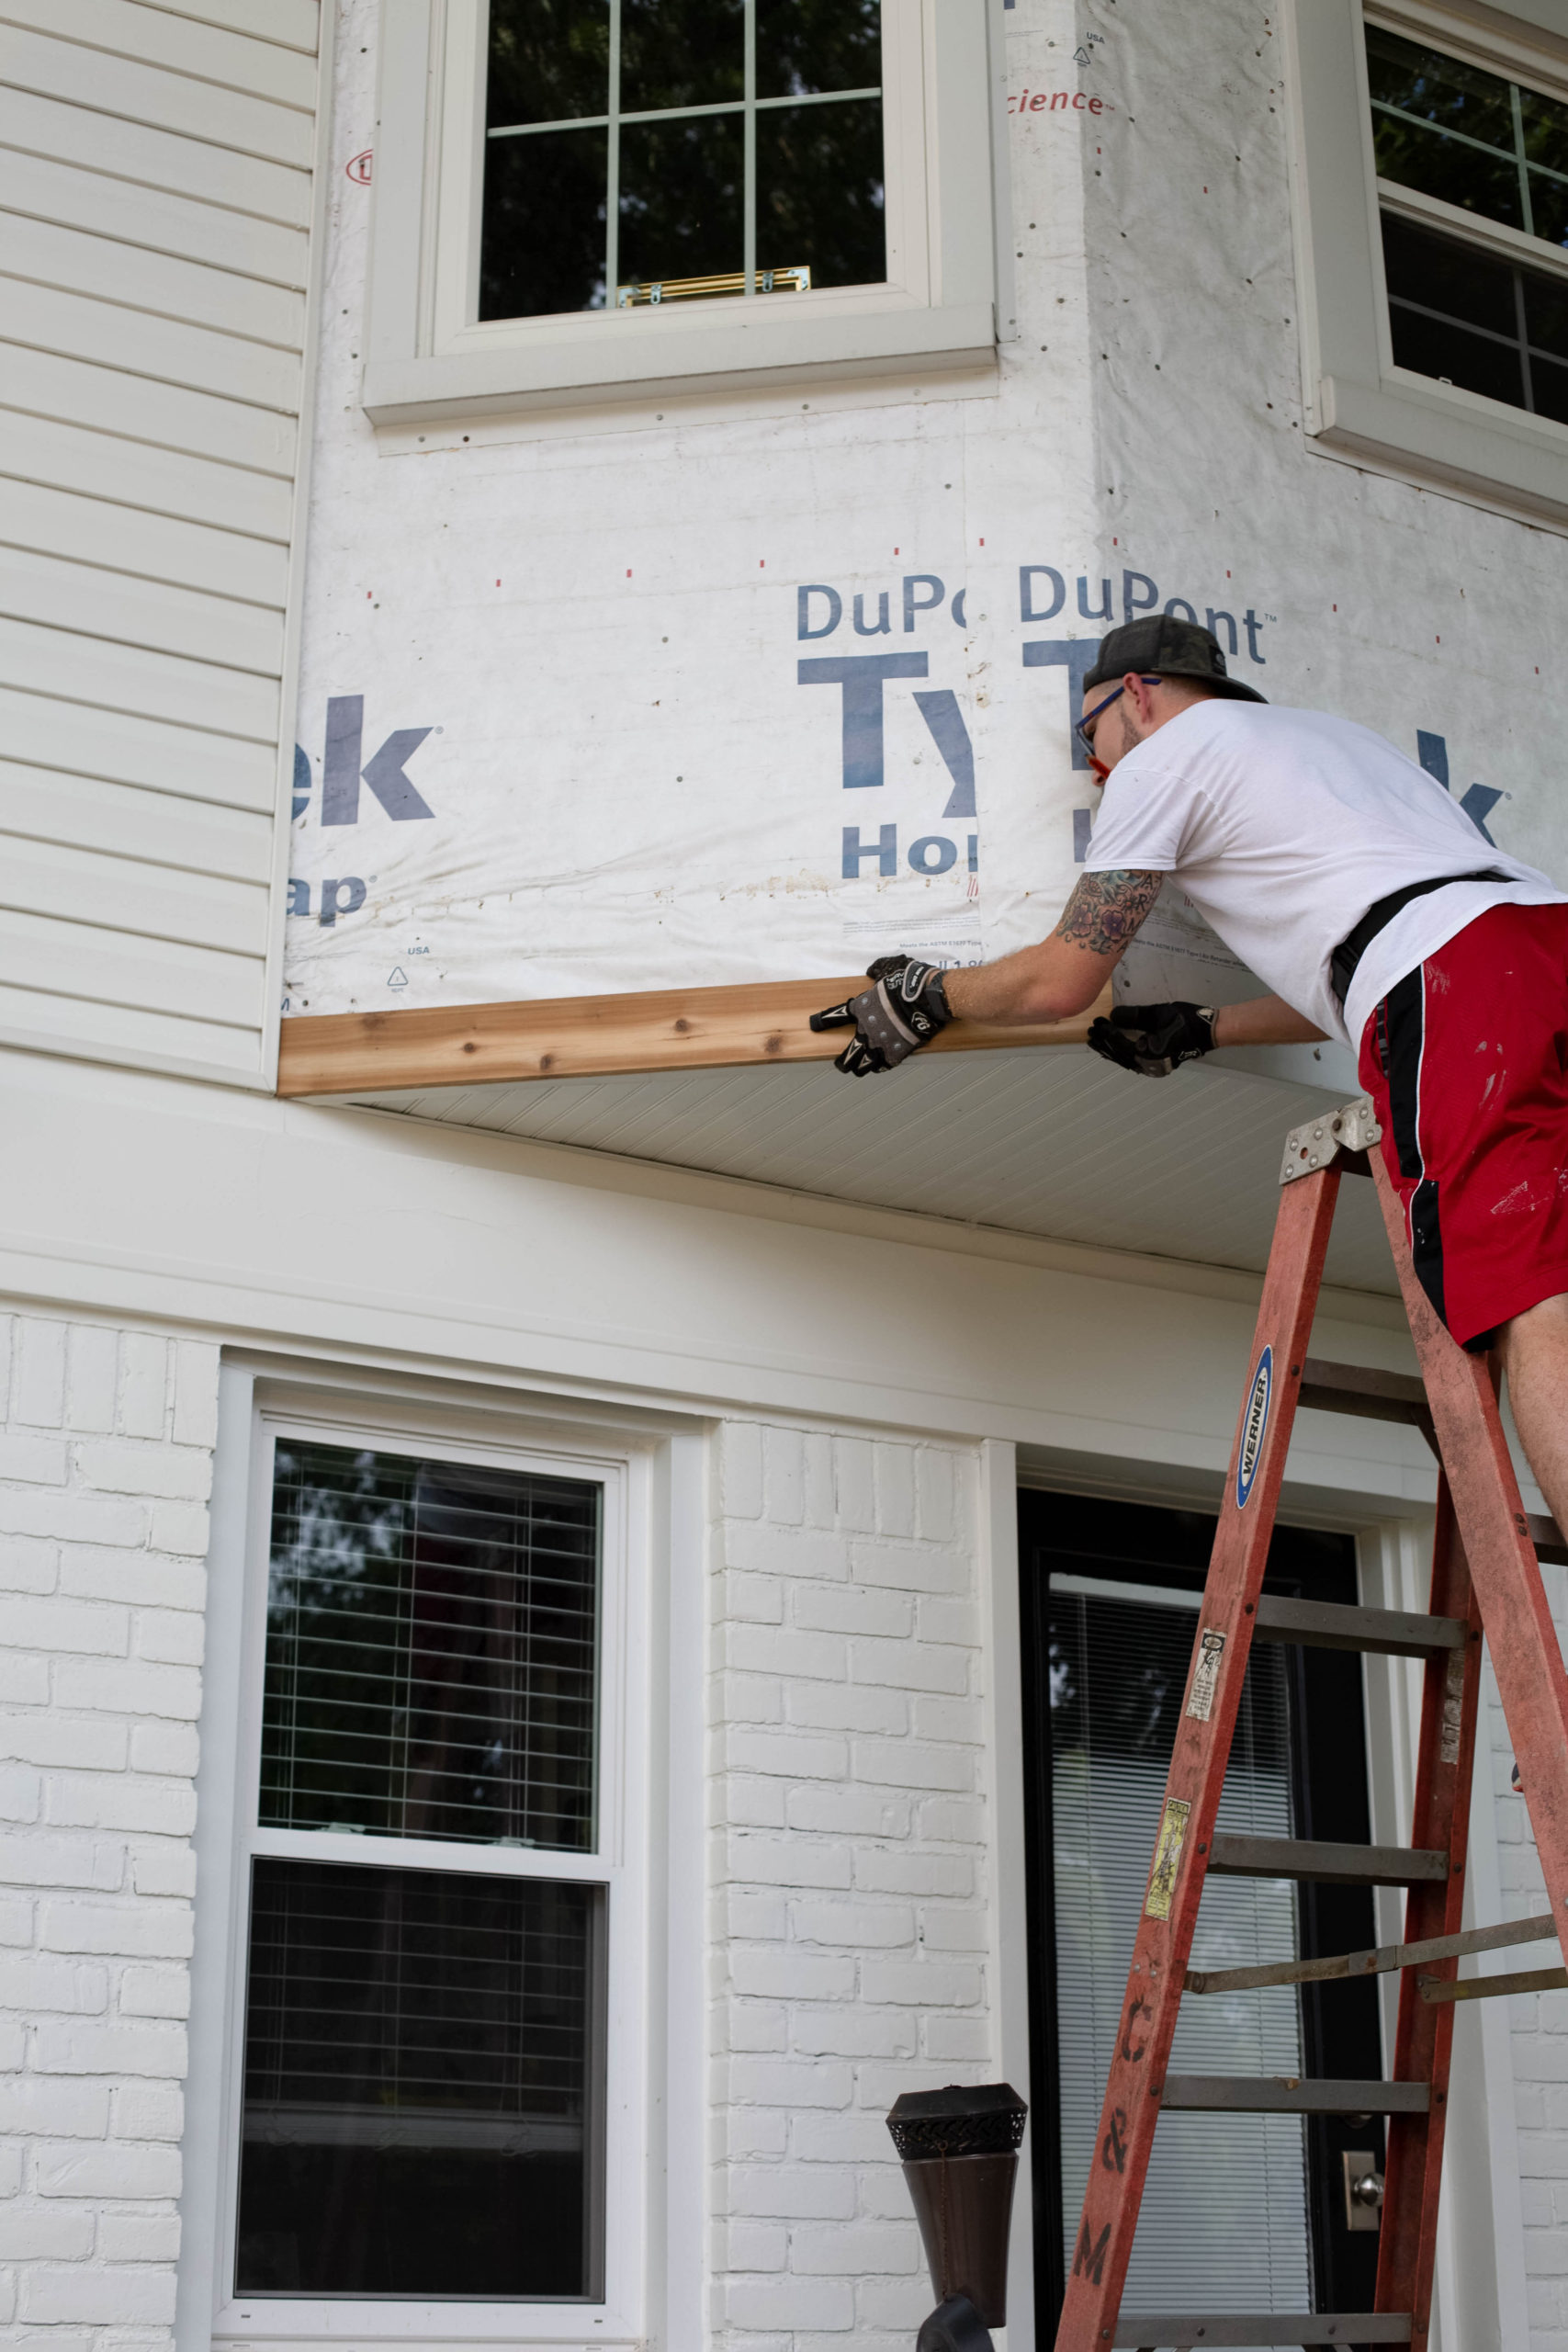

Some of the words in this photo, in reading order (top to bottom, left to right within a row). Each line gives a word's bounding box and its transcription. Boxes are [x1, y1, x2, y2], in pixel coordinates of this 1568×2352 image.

[1086, 31, 1106, 45] USA
[407, 946, 430, 956] USA
[1243, 1377, 1267, 1476] WERNER
